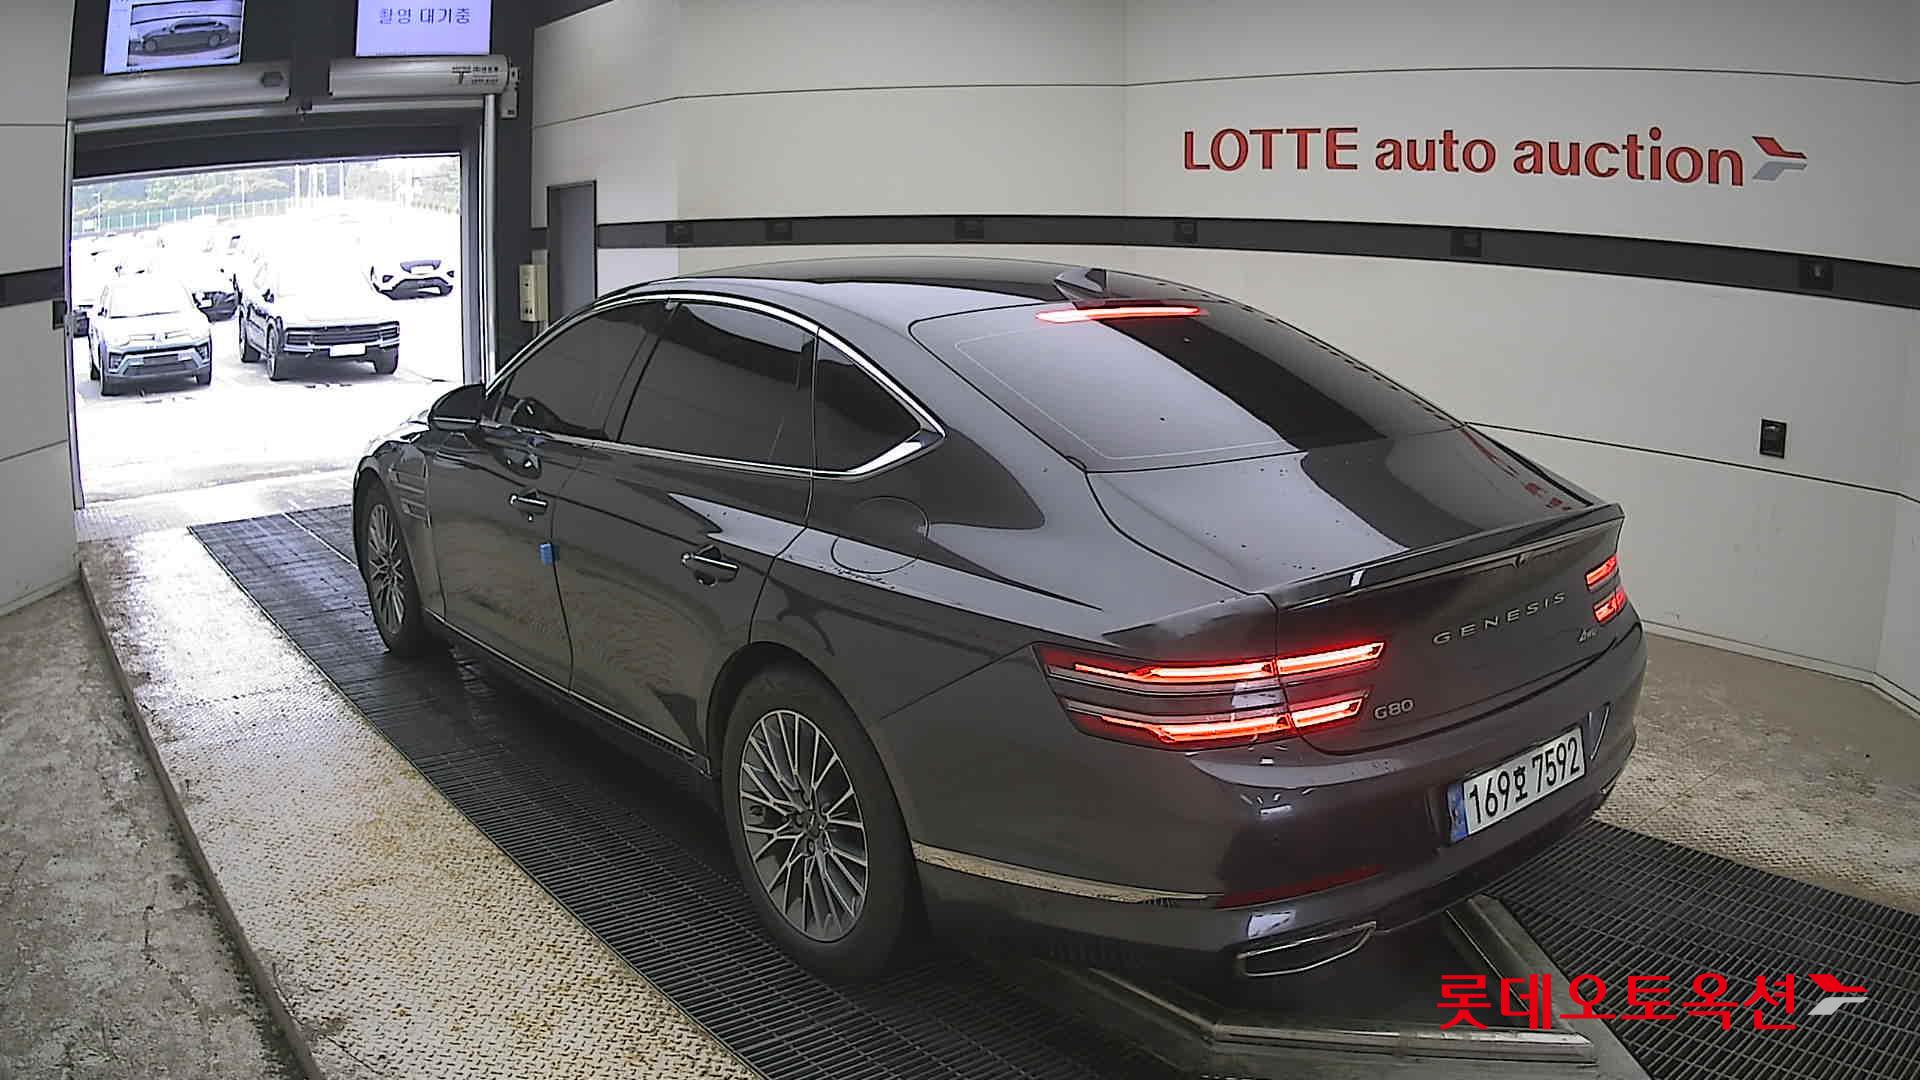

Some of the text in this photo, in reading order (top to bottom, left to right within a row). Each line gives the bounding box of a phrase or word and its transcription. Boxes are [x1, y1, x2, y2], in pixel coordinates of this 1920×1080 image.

[420, 7, 471, 24] 대기중
[1185, 127, 1744, 186] LOTTE auto auction
[1433, 593, 1566, 644] GENESIS
[1374, 699, 1414, 720] G80
[1469, 736, 1580, 823] 169호 7592
